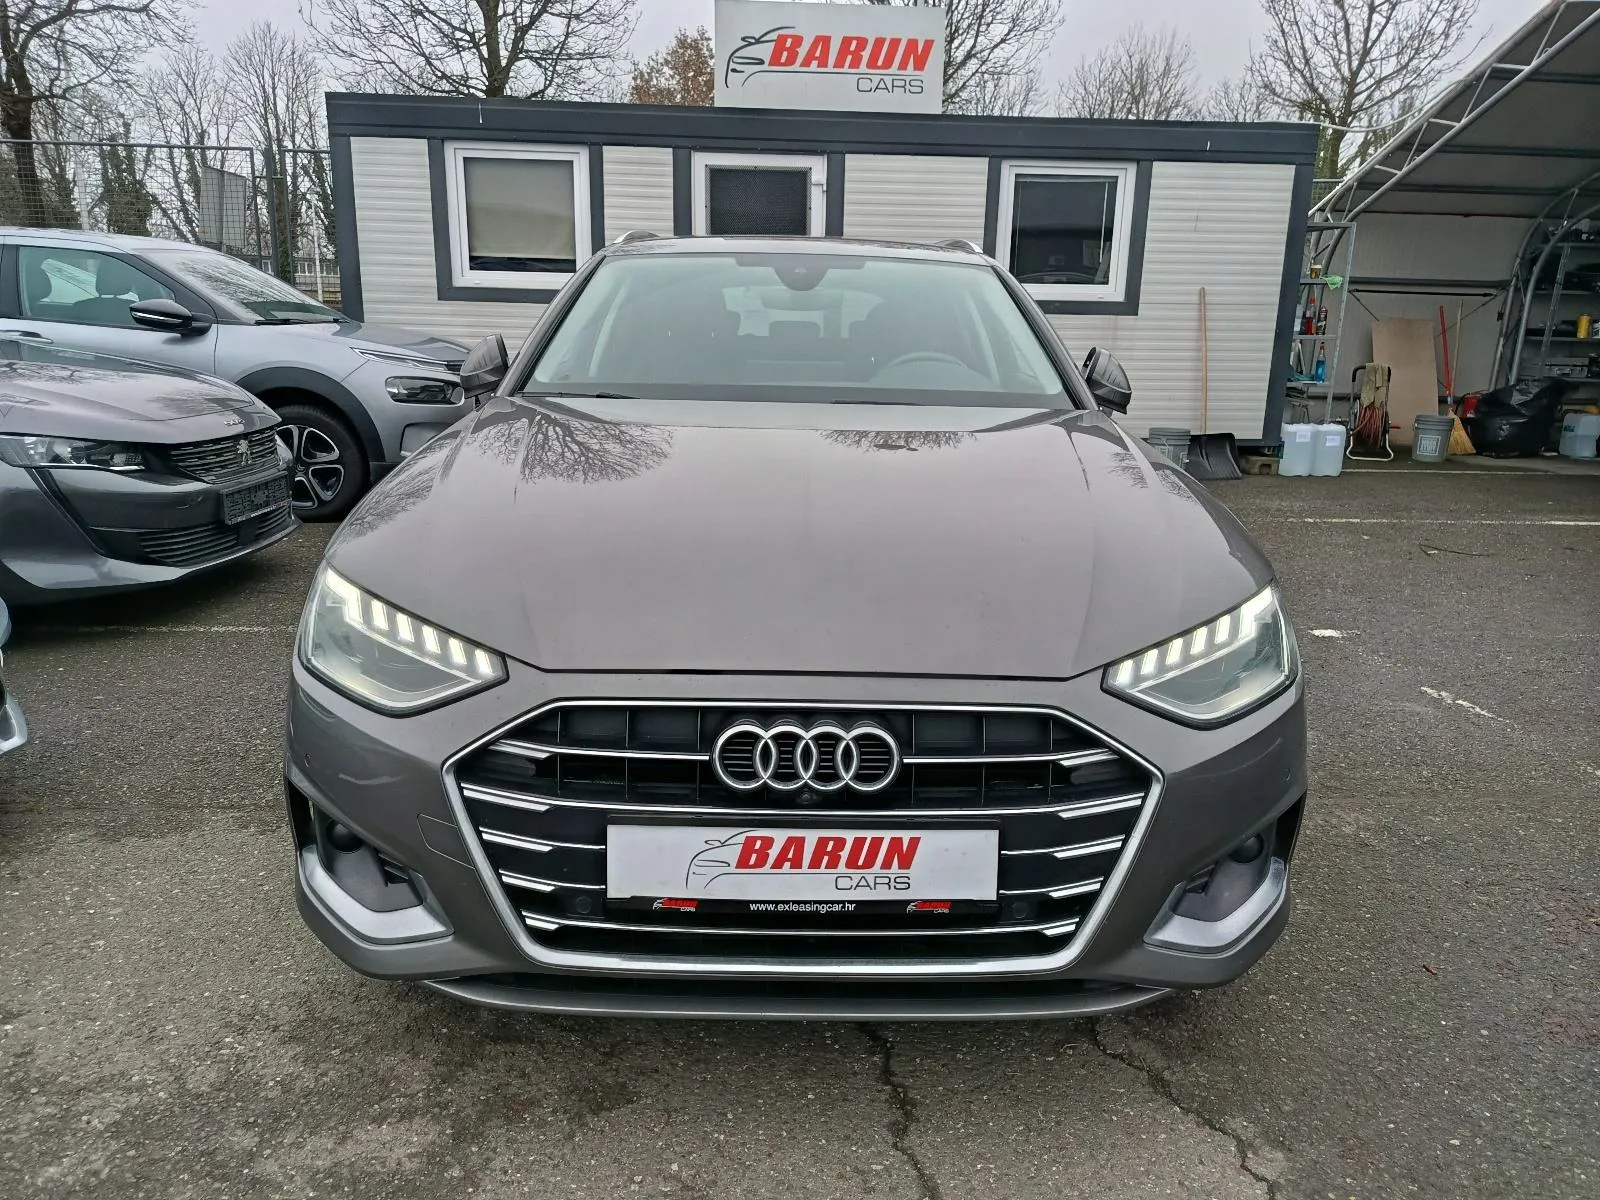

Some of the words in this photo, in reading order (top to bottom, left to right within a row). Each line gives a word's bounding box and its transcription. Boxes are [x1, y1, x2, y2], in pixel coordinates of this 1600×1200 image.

[768, 34, 935, 72] BARUN
[857, 77, 924, 94] CARS
[734, 835, 921, 871] BARUN
[834, 875, 911, 891] CARS
[749, 902, 856, 914] www.exleasingcar.hr
